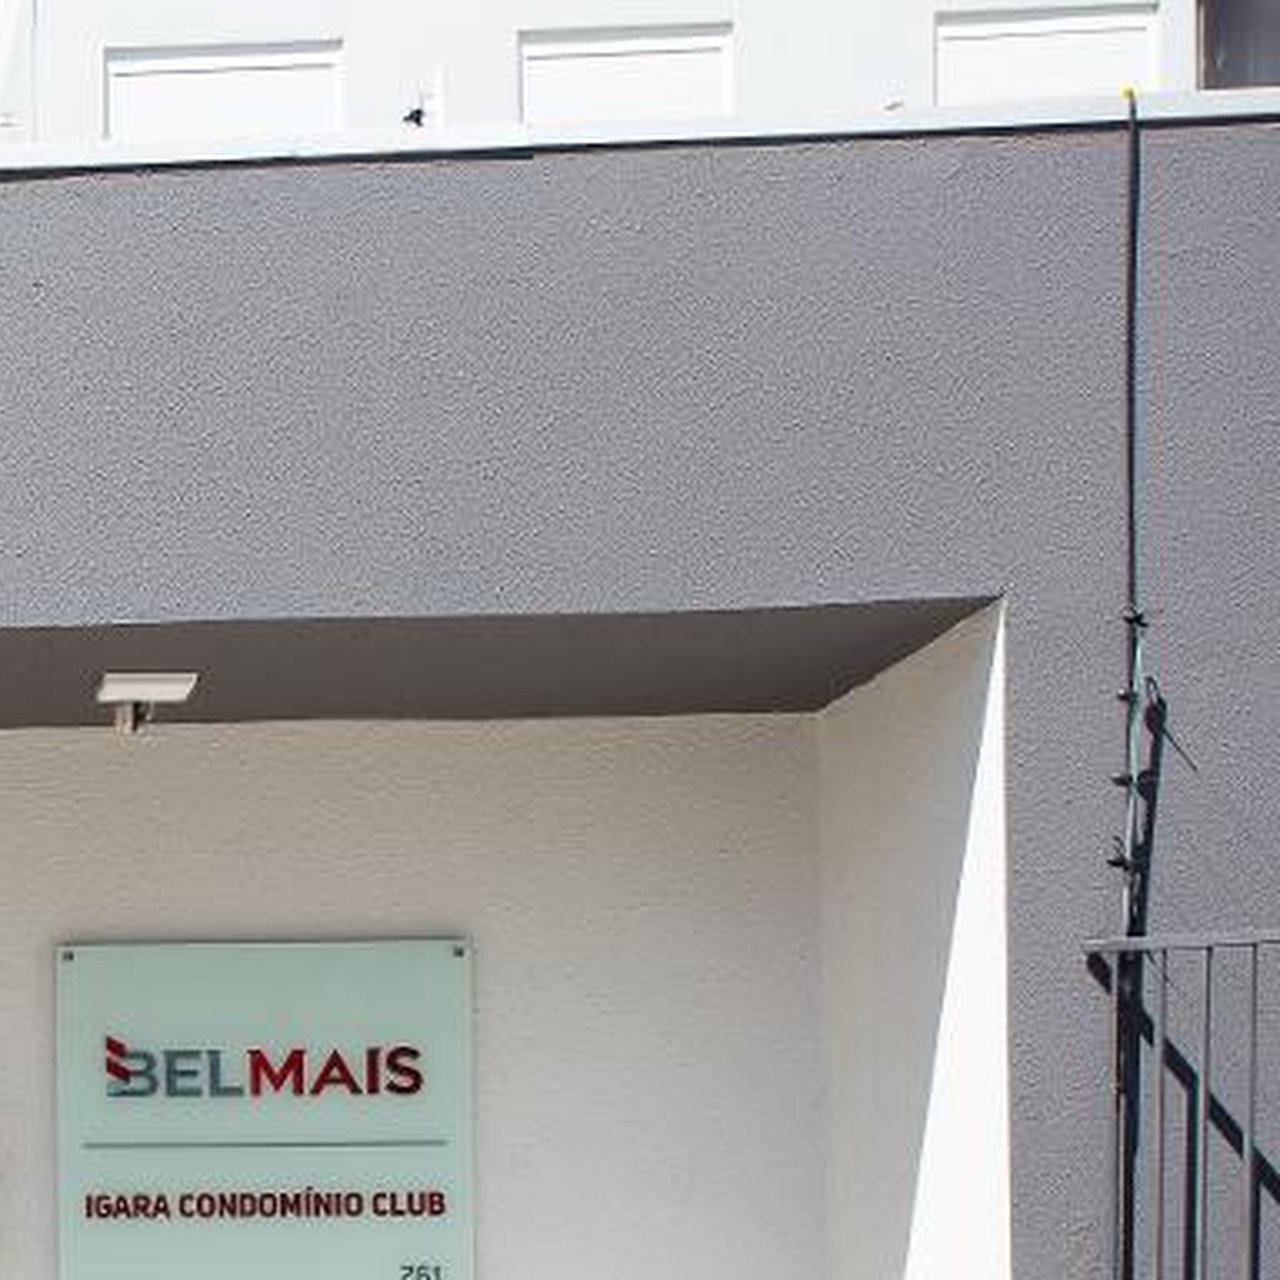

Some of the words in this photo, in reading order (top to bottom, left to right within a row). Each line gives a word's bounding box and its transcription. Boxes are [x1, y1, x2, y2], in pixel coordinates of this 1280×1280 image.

[105, 1036, 424, 1098] BELMAIS
[85, 1194, 171, 1220] IGARA
[178, 1187, 364, 1219] CONDOMÍNIO
[372, 1192, 446, 1218] CLUB
